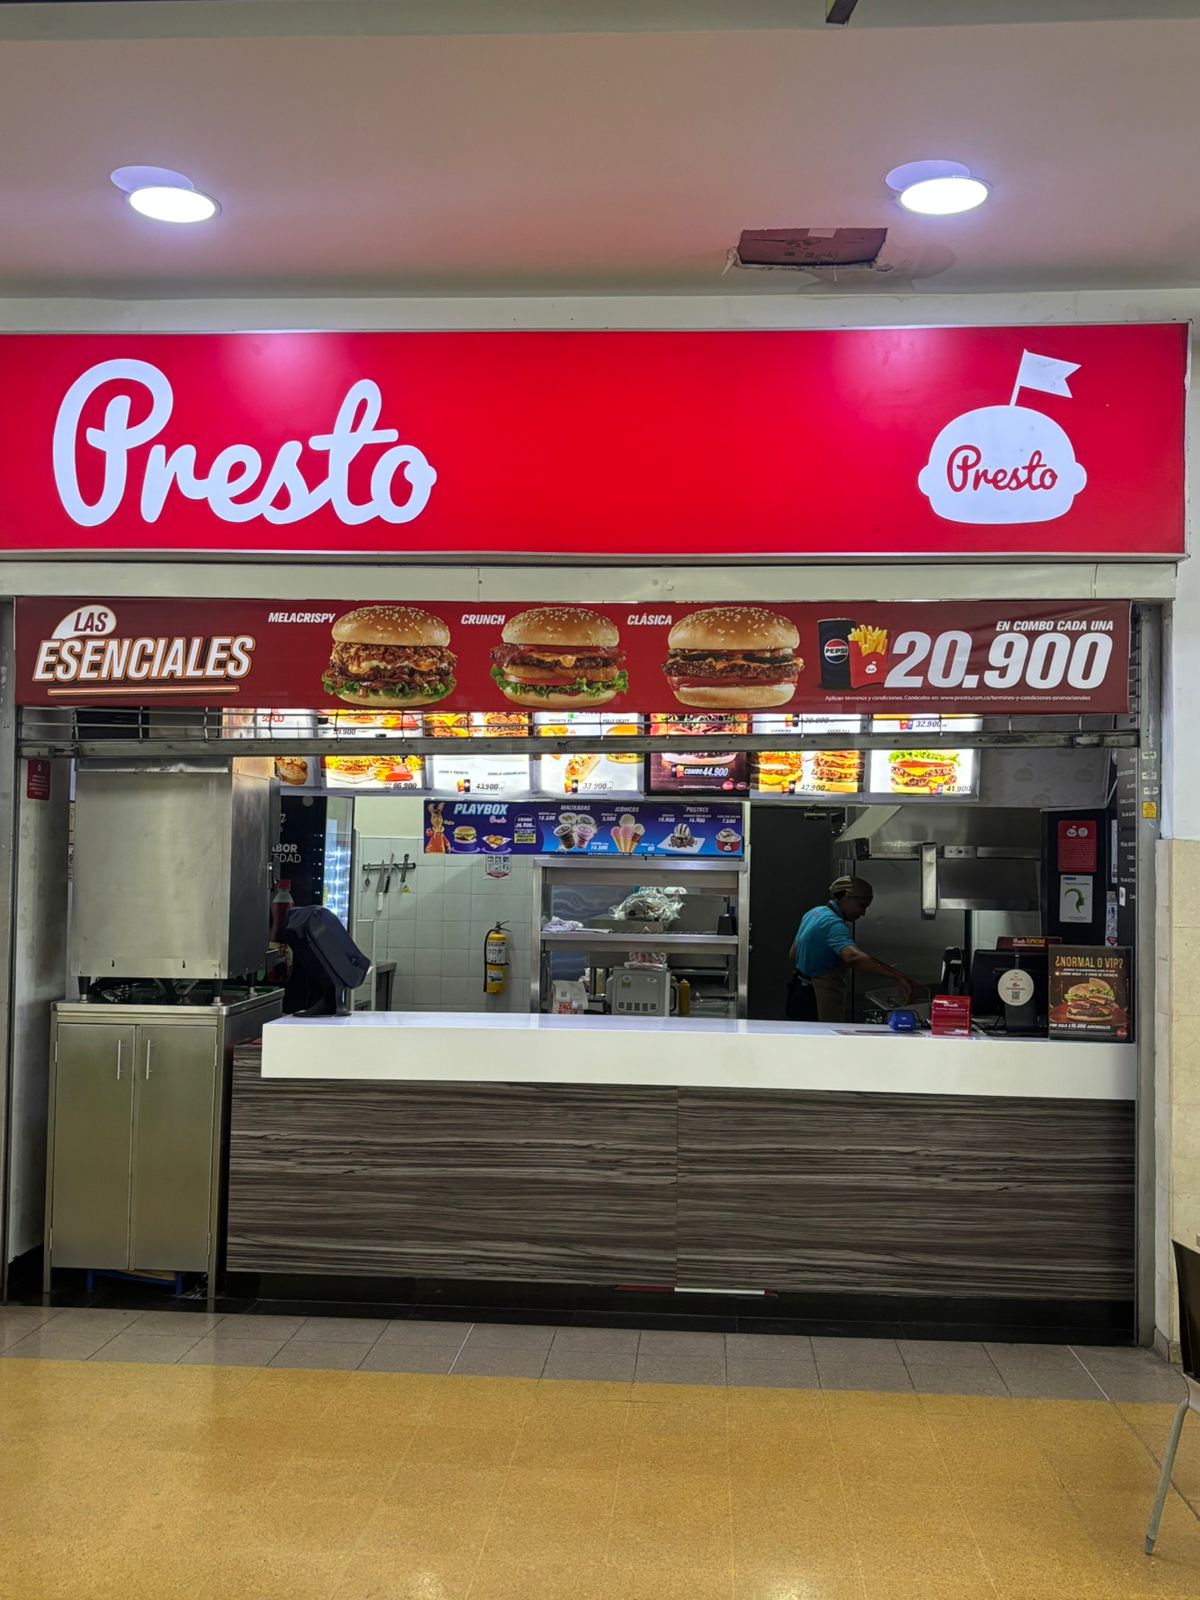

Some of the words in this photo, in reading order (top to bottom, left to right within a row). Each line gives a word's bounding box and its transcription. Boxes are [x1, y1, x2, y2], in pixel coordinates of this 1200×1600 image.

[51, 358, 438, 528] Presto
[946, 444, 1059, 493] Presto
[73, 611, 109, 633] LAS
[267, 612, 337, 625] MELACRISPY
[460, 613, 506, 626] CRUNCH
[626, 611, 673, 627] CLÁSICA
[995, 620, 1011, 632] EN
[1013, 620, 1054, 632] COMBO
[1056, 620, 1088, 631] CADA
[1090, 619, 1114, 632] UNA
[32, 634, 256, 682] ESENCIALES
[825, 647, 848, 655] PEPSI
[883, 629, 1114, 690] 20.900
[453, 803, 509, 816] PLAYBOX
[1055, 955, 1096, 968] ¿NORMAL
[1097, 957, 1103, 968] O
[1104, 957, 1124, 969] VIP?
